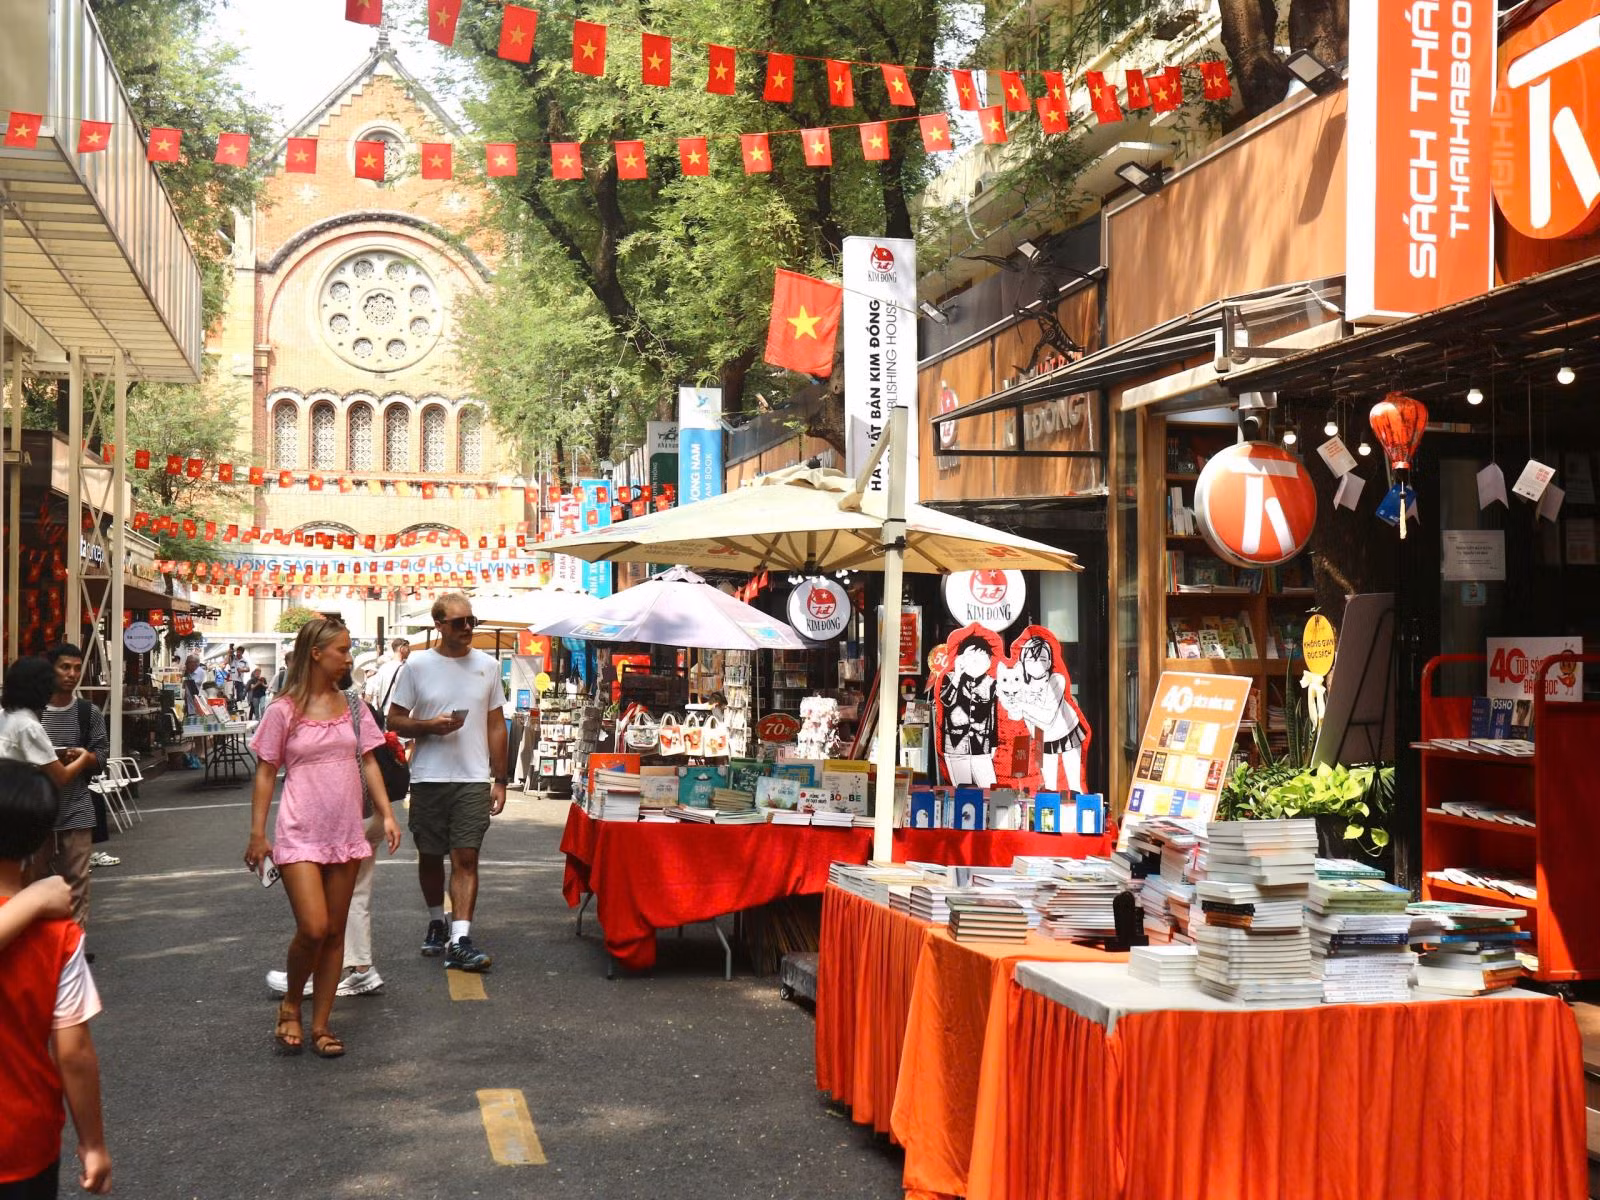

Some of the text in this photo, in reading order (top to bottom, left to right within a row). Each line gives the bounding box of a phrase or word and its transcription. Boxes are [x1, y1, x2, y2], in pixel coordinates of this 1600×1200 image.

[1449, 0, 1472, 238] THAIHABOO
[1402, 129, 1439, 278] SÁCH
[886, 299, 897, 345] HOUSE
[869, 353, 881, 382] KIM
[690, 443, 701, 471] NAM
[704, 453, 713, 498] AM BOOK
[806, 618, 820, 631] KIM
[967, 603, 984, 621] KIM
[1489, 647, 1526, 684] 40
[1160, 685, 1194, 713] 40
[1492, 699, 1514, 710] OSHO
